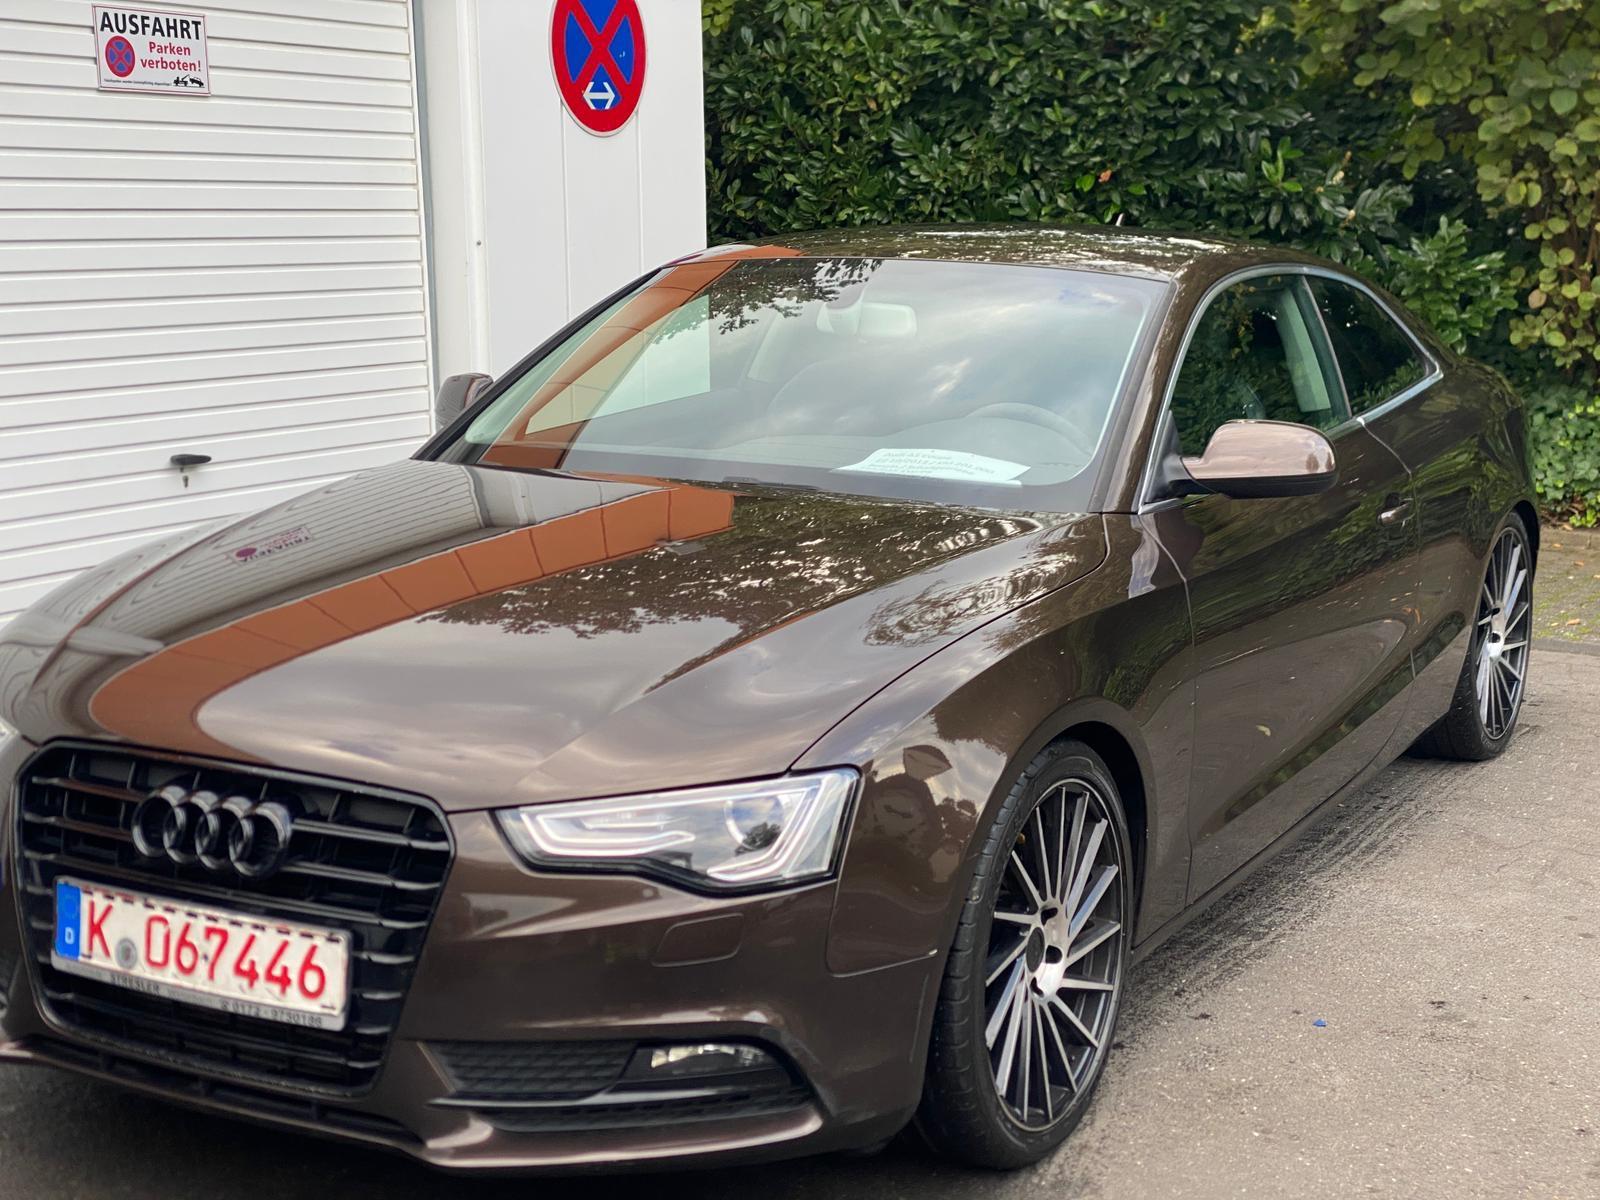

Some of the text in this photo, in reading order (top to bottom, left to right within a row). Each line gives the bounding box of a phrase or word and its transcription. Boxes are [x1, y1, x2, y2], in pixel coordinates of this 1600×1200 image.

[100, 12, 201, 40] AUSFAHRT
[149, 41, 191, 56] Parken
[140, 57, 201, 72] verboten!
[65, 927, 74, 945] D
[87, 900, 326, 999] K 067446
